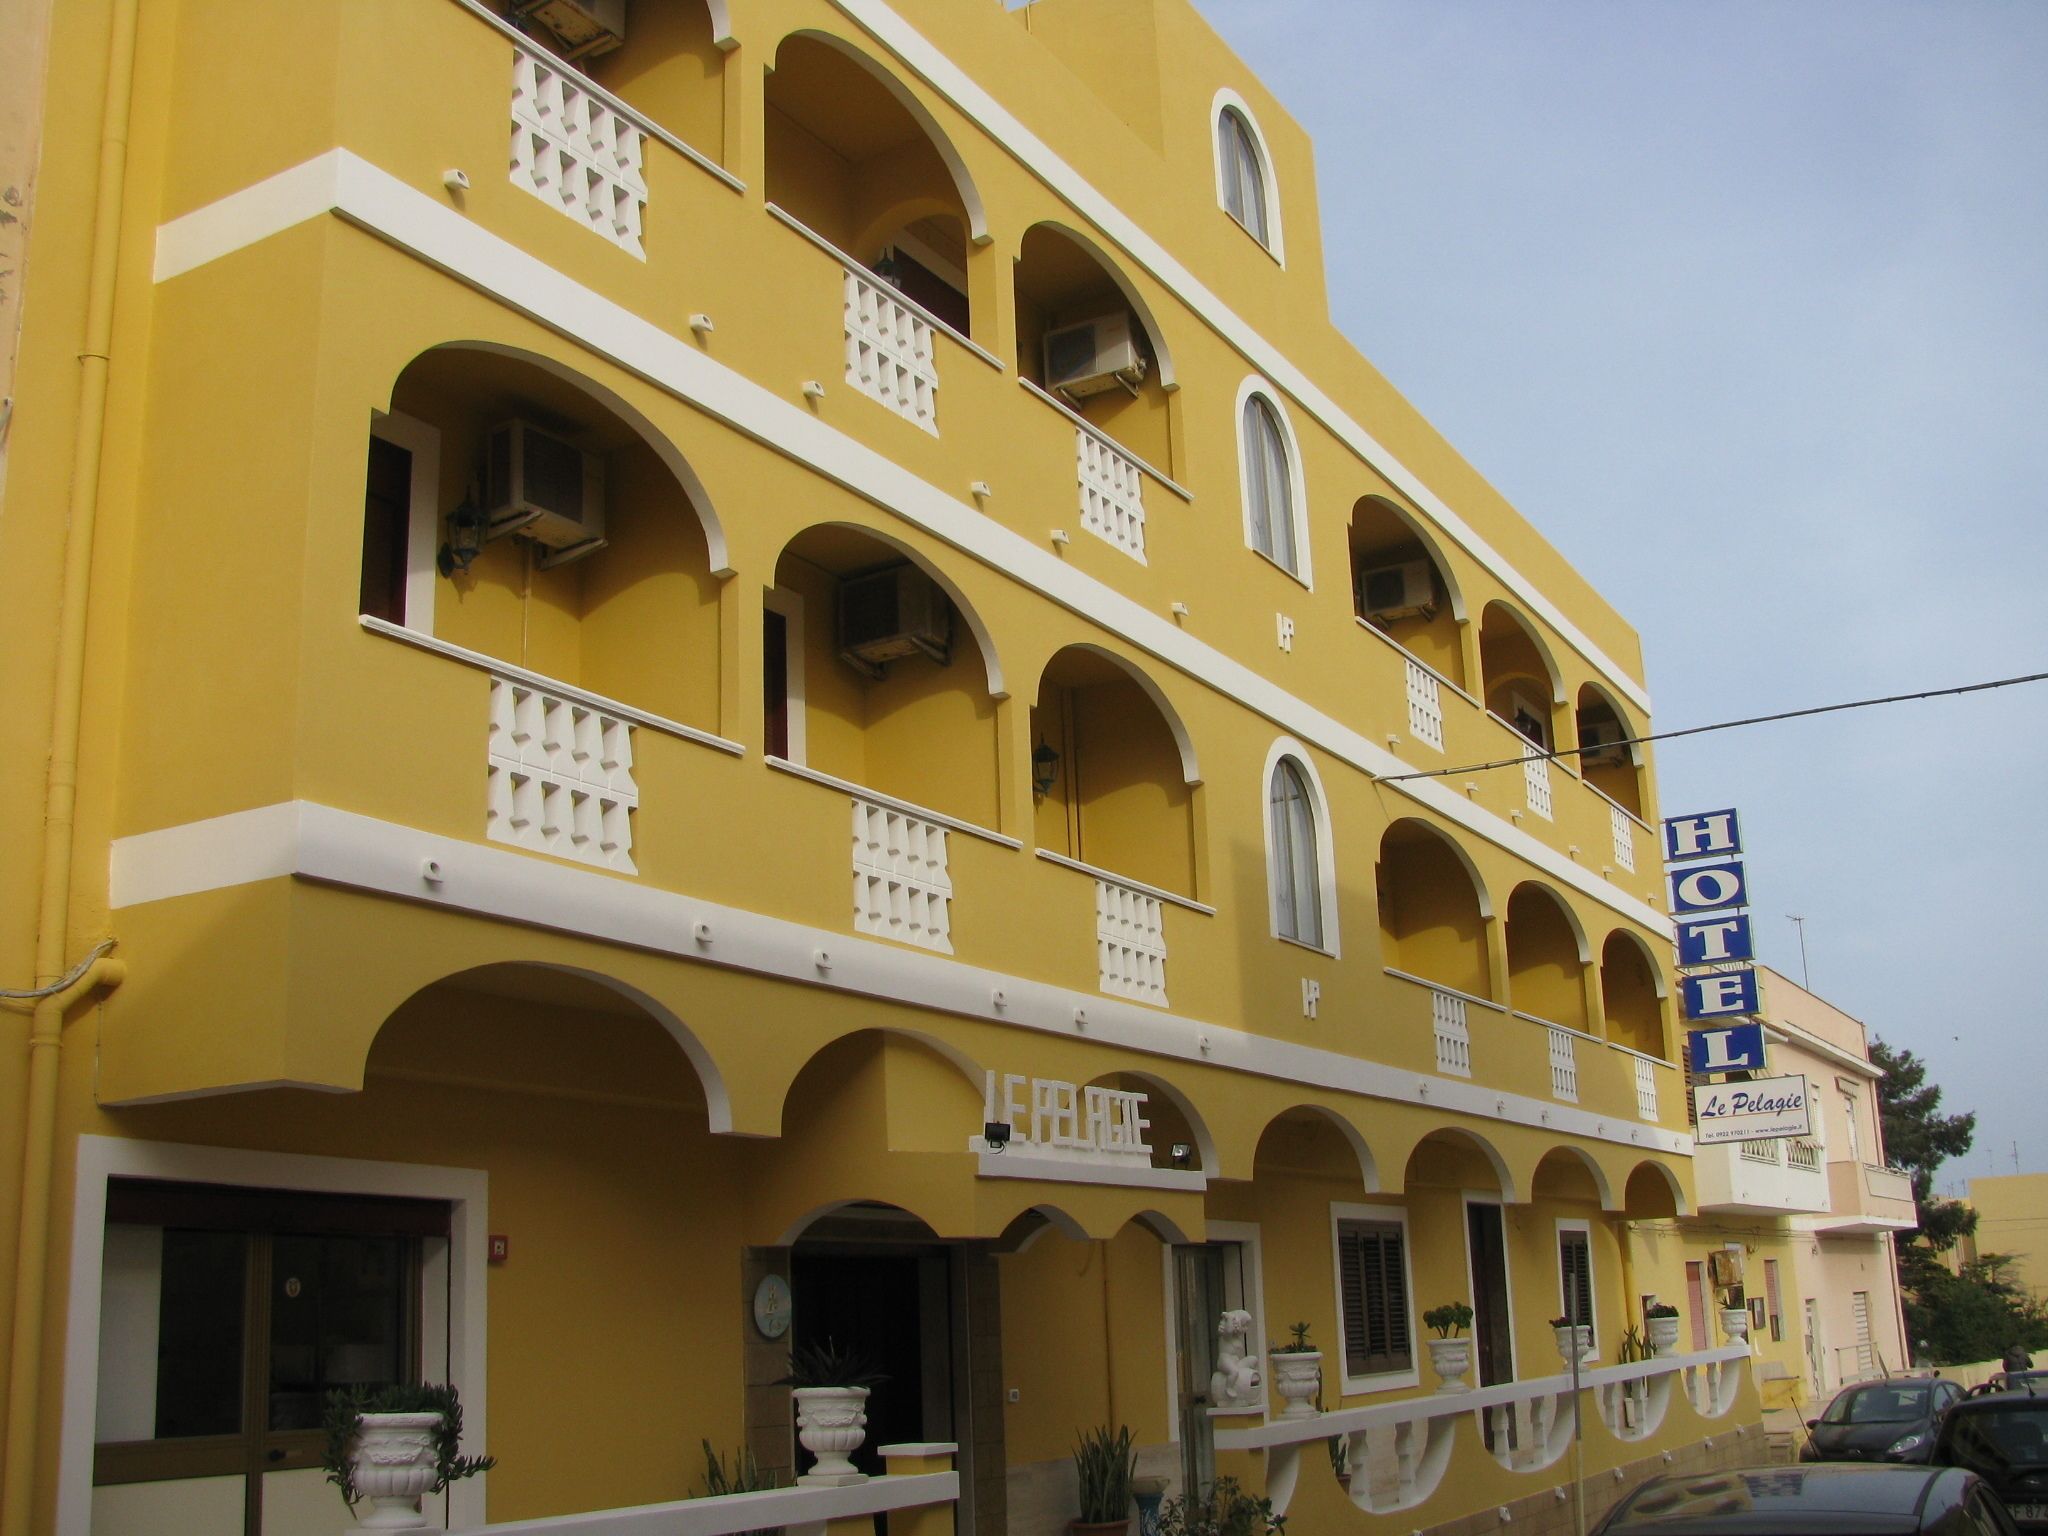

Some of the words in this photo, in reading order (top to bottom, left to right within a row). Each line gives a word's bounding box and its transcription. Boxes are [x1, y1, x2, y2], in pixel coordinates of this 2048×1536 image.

[1671, 812, 1750, 1069] HOTEL
[983, 1070, 1027, 1143] LE
[1031, 1077, 1153, 1154] PELAGIE
[1701, 1095, 1726, 1117] Le
[1731, 1092, 1802, 1116] Pelagie
